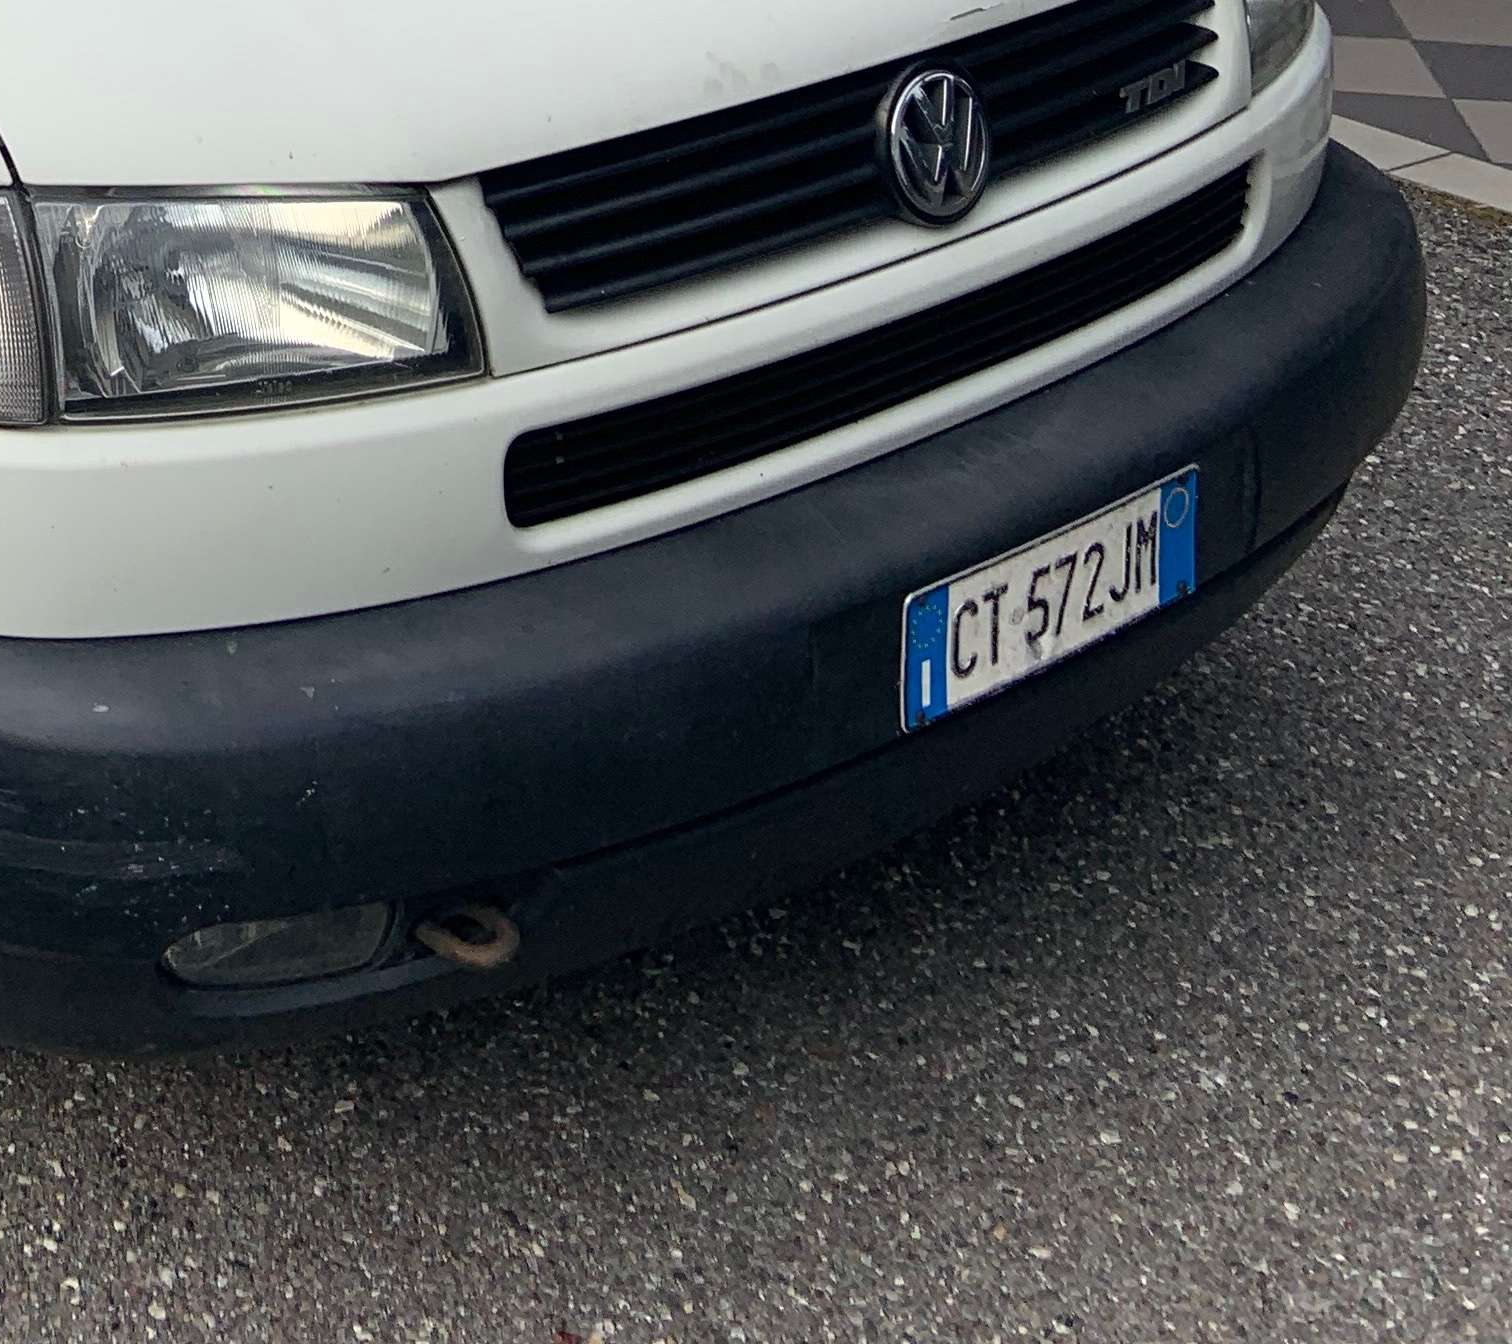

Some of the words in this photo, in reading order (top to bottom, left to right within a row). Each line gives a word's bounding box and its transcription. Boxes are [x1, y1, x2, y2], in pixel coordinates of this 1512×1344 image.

[1119, 60, 1187, 113] TDI
[921, 658, 931, 708] I
[951, 583, 1008, 678] CT
